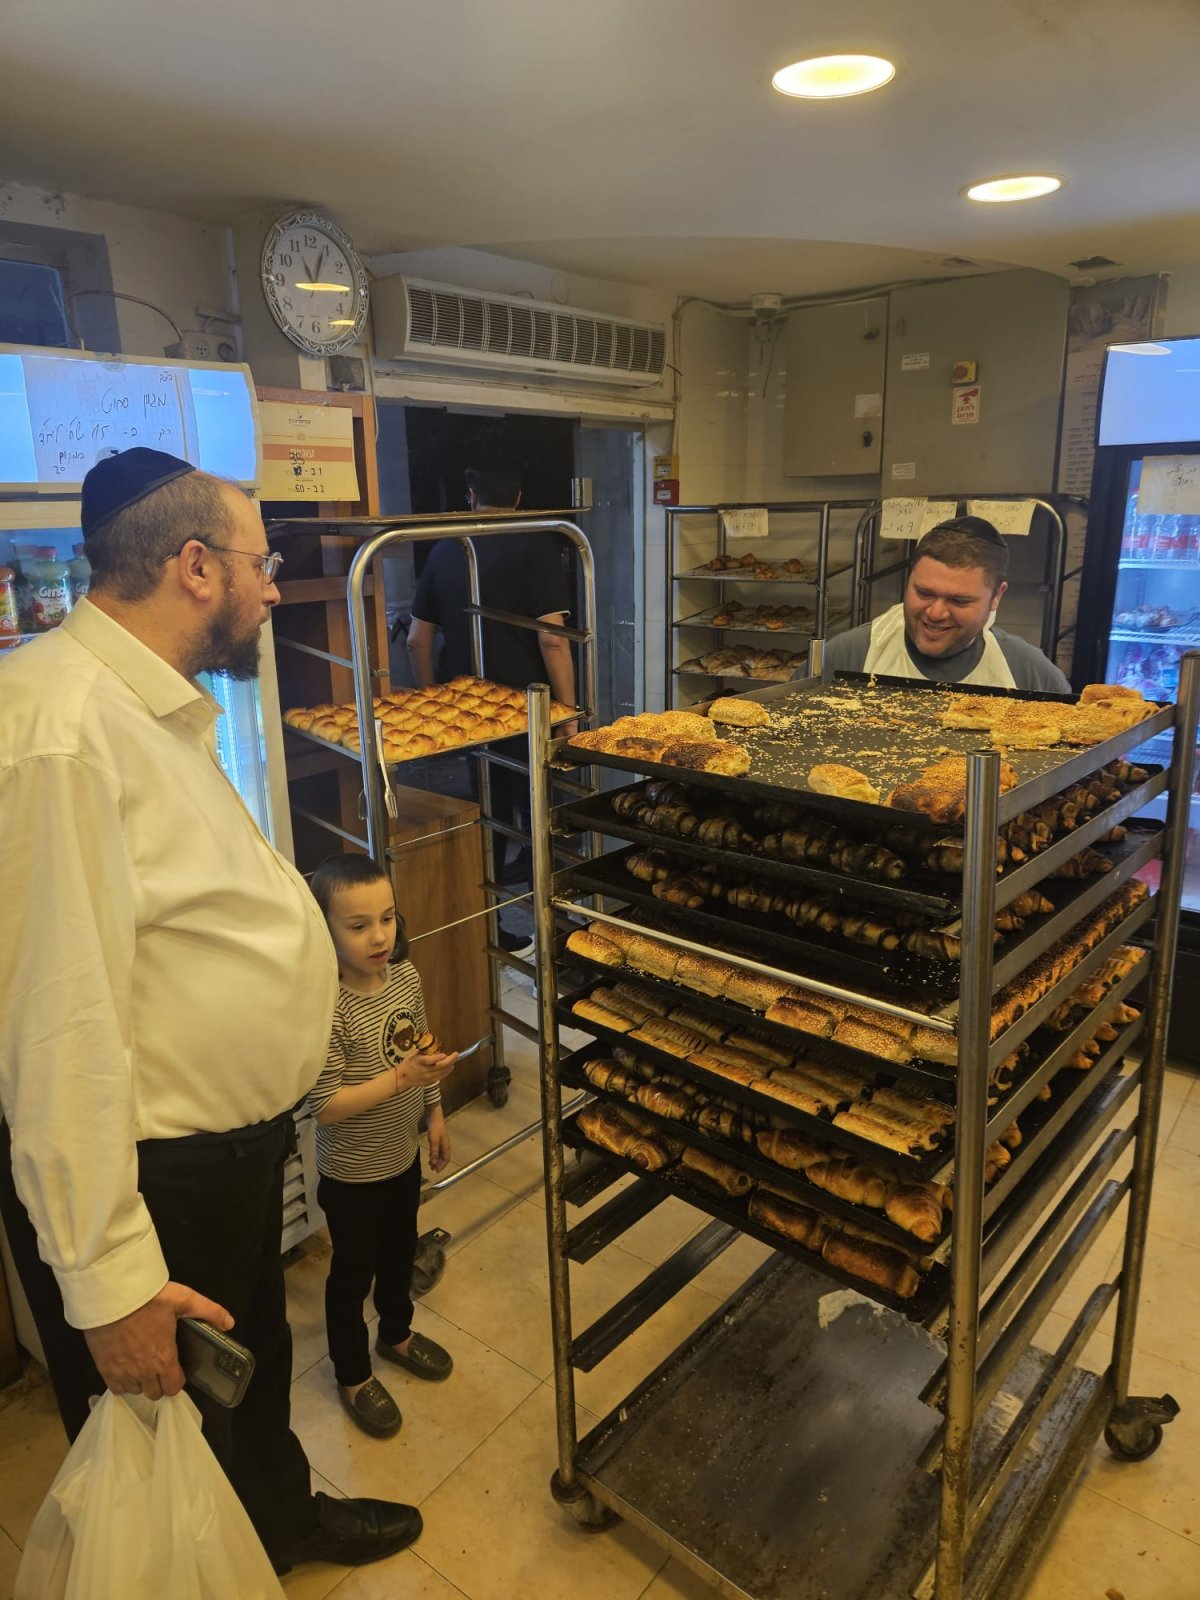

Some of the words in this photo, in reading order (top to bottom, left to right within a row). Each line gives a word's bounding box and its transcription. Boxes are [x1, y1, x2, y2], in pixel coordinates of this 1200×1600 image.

[290, 240, 300, 253] 11
[303, 235, 317, 249] 12
[279, 254, 292, 267] 10
[335, 262, 343, 274] 2
[276, 273, 285, 287] 9
[282, 296, 293, 311] 8
[335, 303, 344, 315] 4
[296, 316, 305, 328] 7
[312, 321, 321, 334] 6
[957, 404, 975, 413] לחצן
